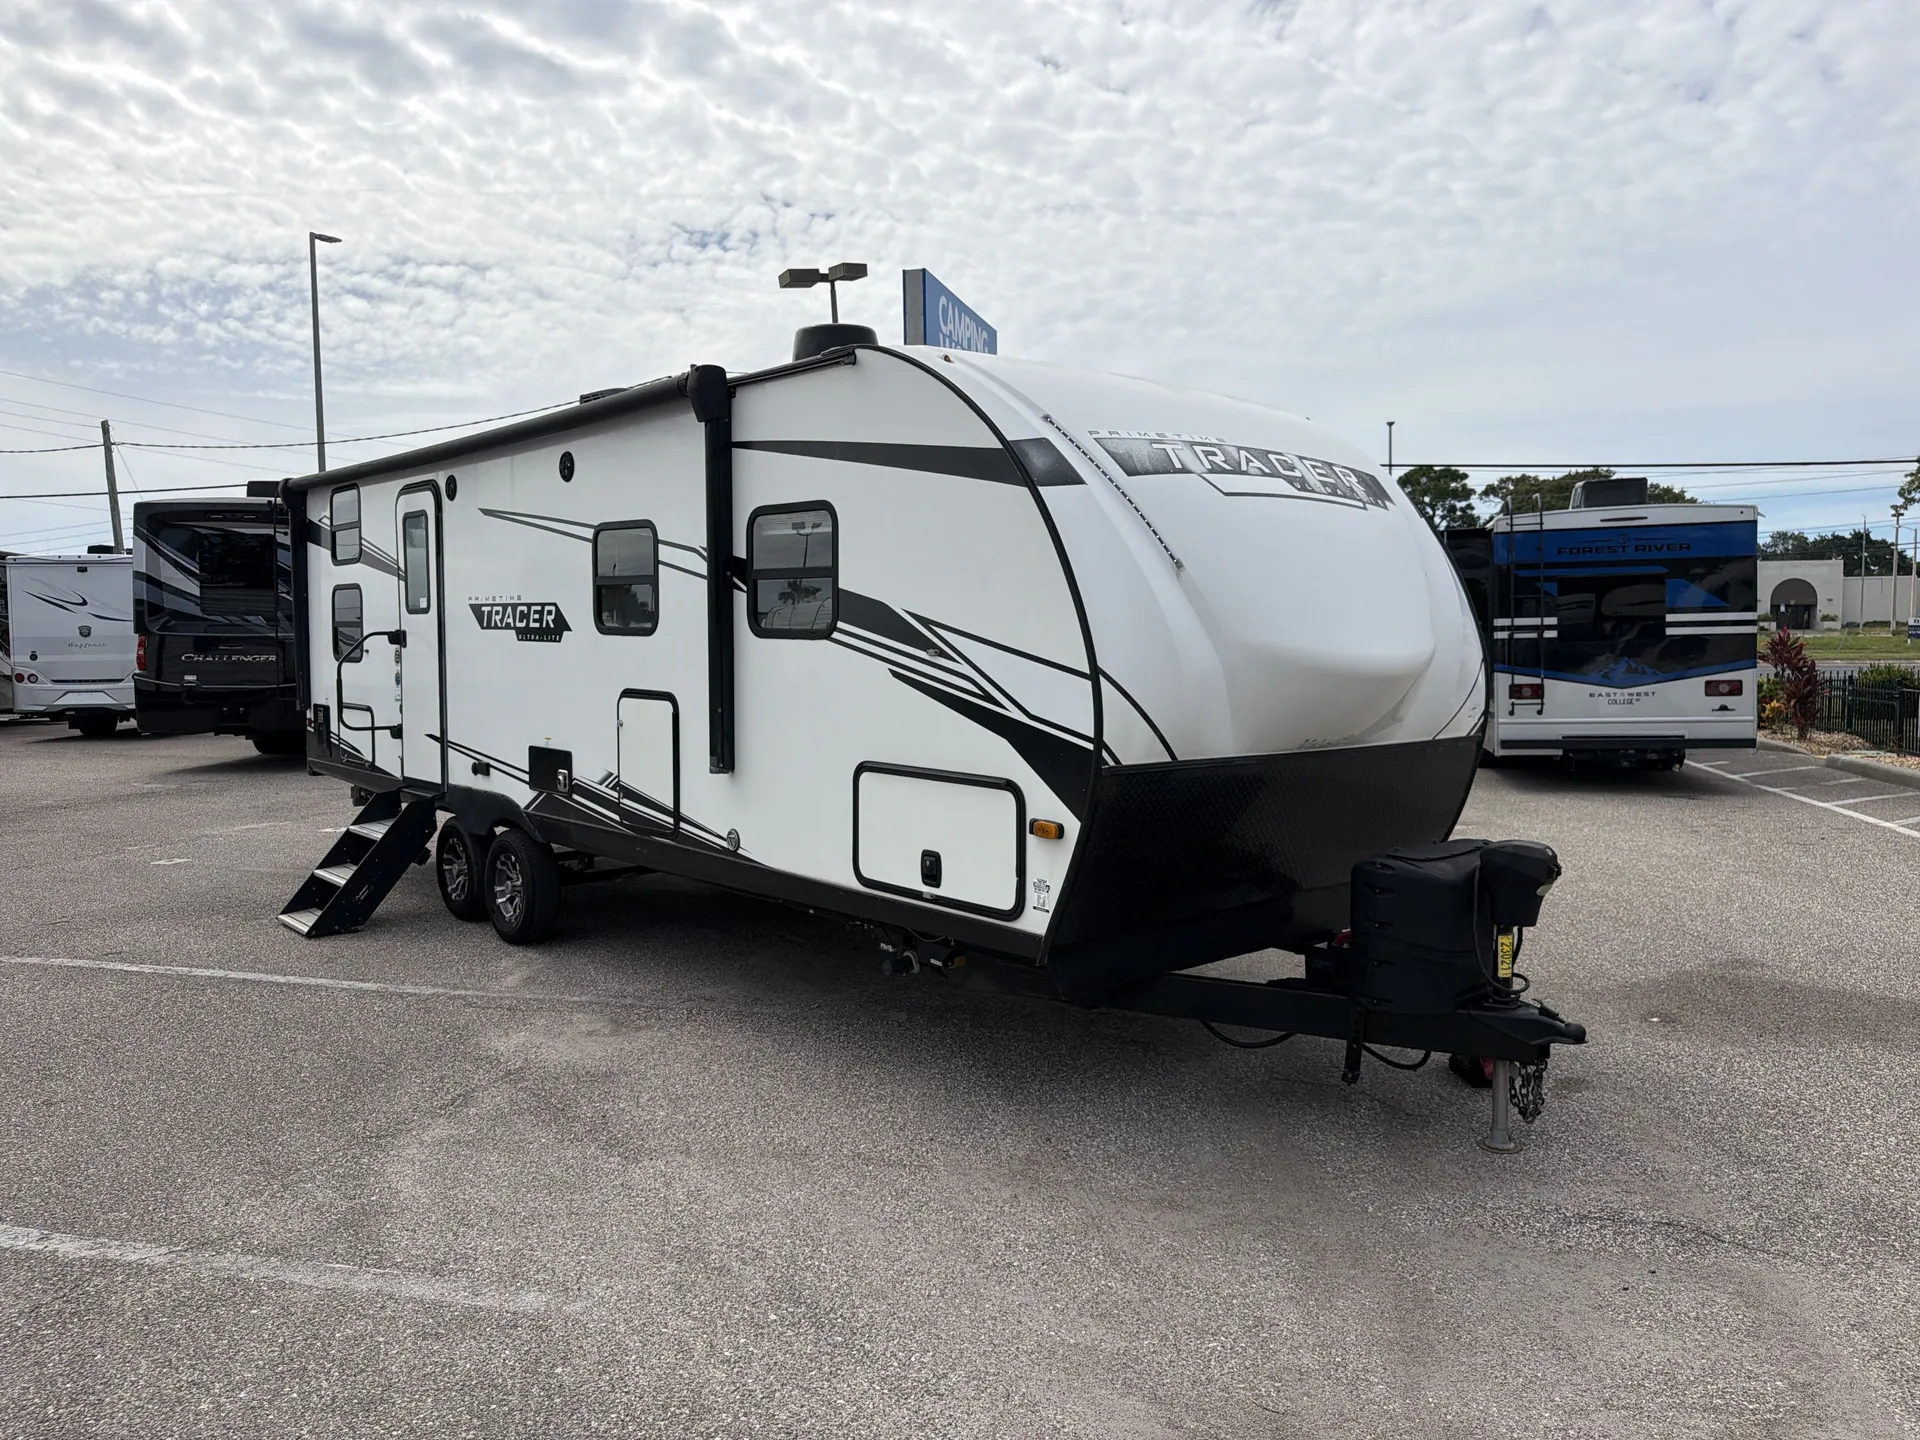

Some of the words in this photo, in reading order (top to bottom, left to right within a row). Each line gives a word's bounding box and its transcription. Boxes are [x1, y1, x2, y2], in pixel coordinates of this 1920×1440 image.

[938, 295, 989, 354] CAMPING
[1088, 430, 1227, 443] PRIMETIME
[1151, 442, 1366, 492] TRACER
[1557, 544, 1630, 555] FOREST
[1634, 542, 1691, 553] RIVER
[481, 605, 556, 628] TRACER
[181, 653, 277, 662] CHALLENGER
